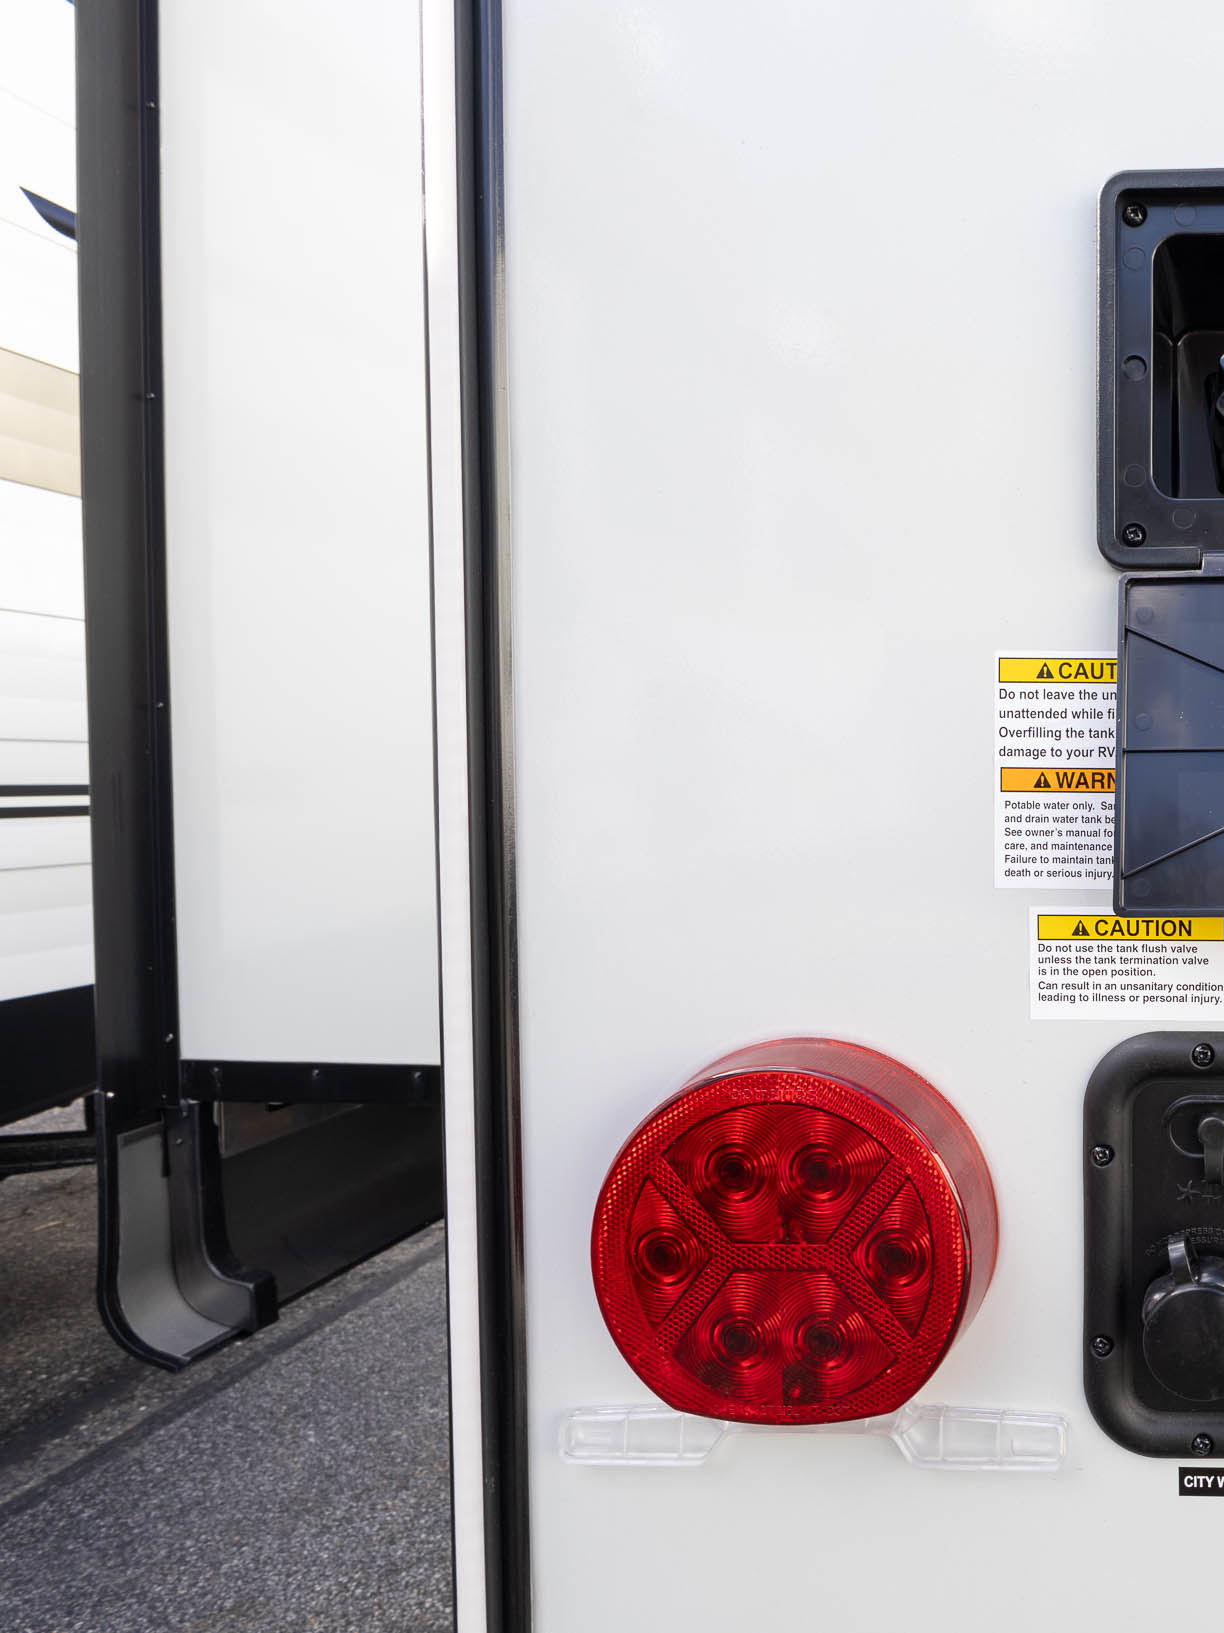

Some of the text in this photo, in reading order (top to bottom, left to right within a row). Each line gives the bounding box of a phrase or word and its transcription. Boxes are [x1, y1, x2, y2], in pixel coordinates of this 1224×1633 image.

[1059, 662, 1117, 679] CAUT
[1000, 689, 1117, 700] Do not leave the un
[1000, 708, 1067, 719] unattended
[1072, 708, 1103, 719] while
[999, 727, 1115, 741] Overfilling the tank
[999, 746, 1046, 760] damage
[1051, 747, 1062, 757] to
[1066, 749, 1094, 760] your
[1056, 772, 1116, 790] WARN
[1005, 801, 1116, 812] Potable water only. Sa
[1005, 814, 1116, 825] and drain water tank be
[1005, 828, 1113, 837] See owner's manual fo
[1005, 842, 1112, 851] care, and maintenance
[1005, 855, 1037, 863] Failure
[1053, 855, 1093, 864] maintain
[1005, 868, 1030, 876] death
[1047, 869, 1082, 877] serious
[1085, 868, 1115, 882] injury.
[1095, 920, 1192, 936] CAUTION
[1038, 944, 1052, 952] Do
[1056, 944, 1072, 952] not
[1097, 944, 1113, 952] the
[1116, 944, 1138, 952] tank
[1142, 944, 1167, 953] flush
[1171, 945, 1197, 953] valve
[1038, 955, 1209, 965] unless the tank termination valve
[1039, 967, 1155, 978] is in the open position.
[1039, 981, 1057, 990] Can
[1062, 981, 1089, 990] result
[1093, 981, 1101, 990] in
[1120, 982, 1173, 993] unsanitary
[1176, 982, 1223, 991] condition
[1039, 993, 1075, 1004] leading
[1093, 993, 1125, 1002] illness
[1143, 994, 1187, 1004] personal
[1191, 994, 1222, 1005] injury.
[1184, 1476, 1214, 1487] CITY
